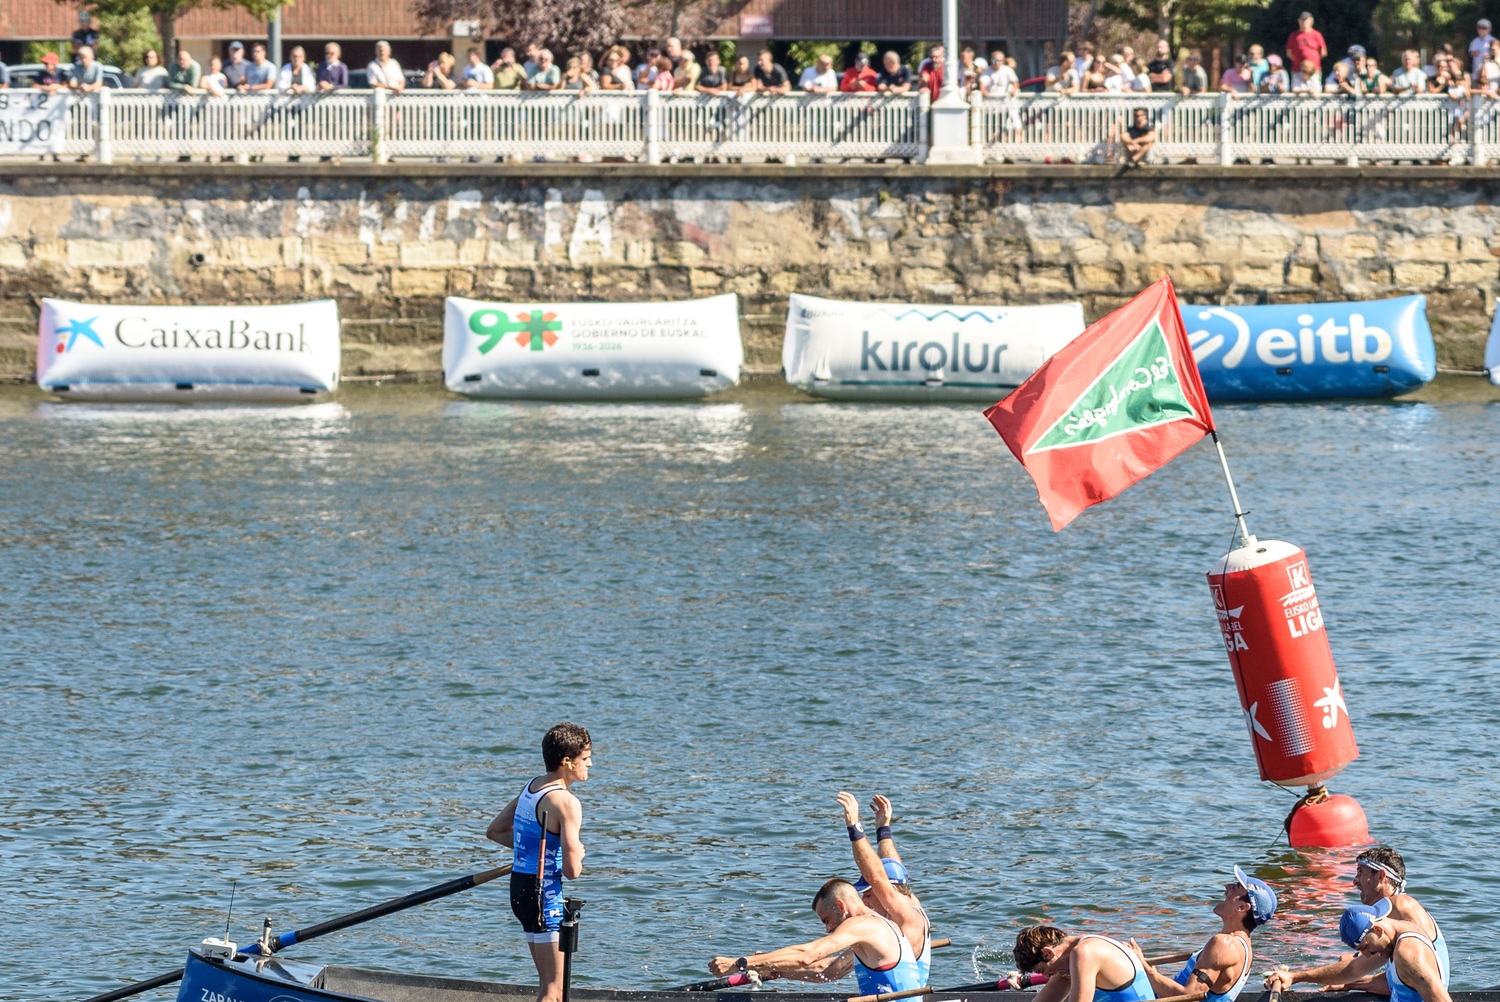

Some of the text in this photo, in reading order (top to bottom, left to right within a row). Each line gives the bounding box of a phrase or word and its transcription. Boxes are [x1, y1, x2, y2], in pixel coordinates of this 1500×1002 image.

[571, 319, 612, 327] EUSKO
[571, 328, 638, 339] GOBIERNO
[641, 328, 657, 338] DE
[1256, 313, 1392, 364] eitb
[1291, 565, 1308, 589] K
[1284, 601, 1309, 618] EUSKO
